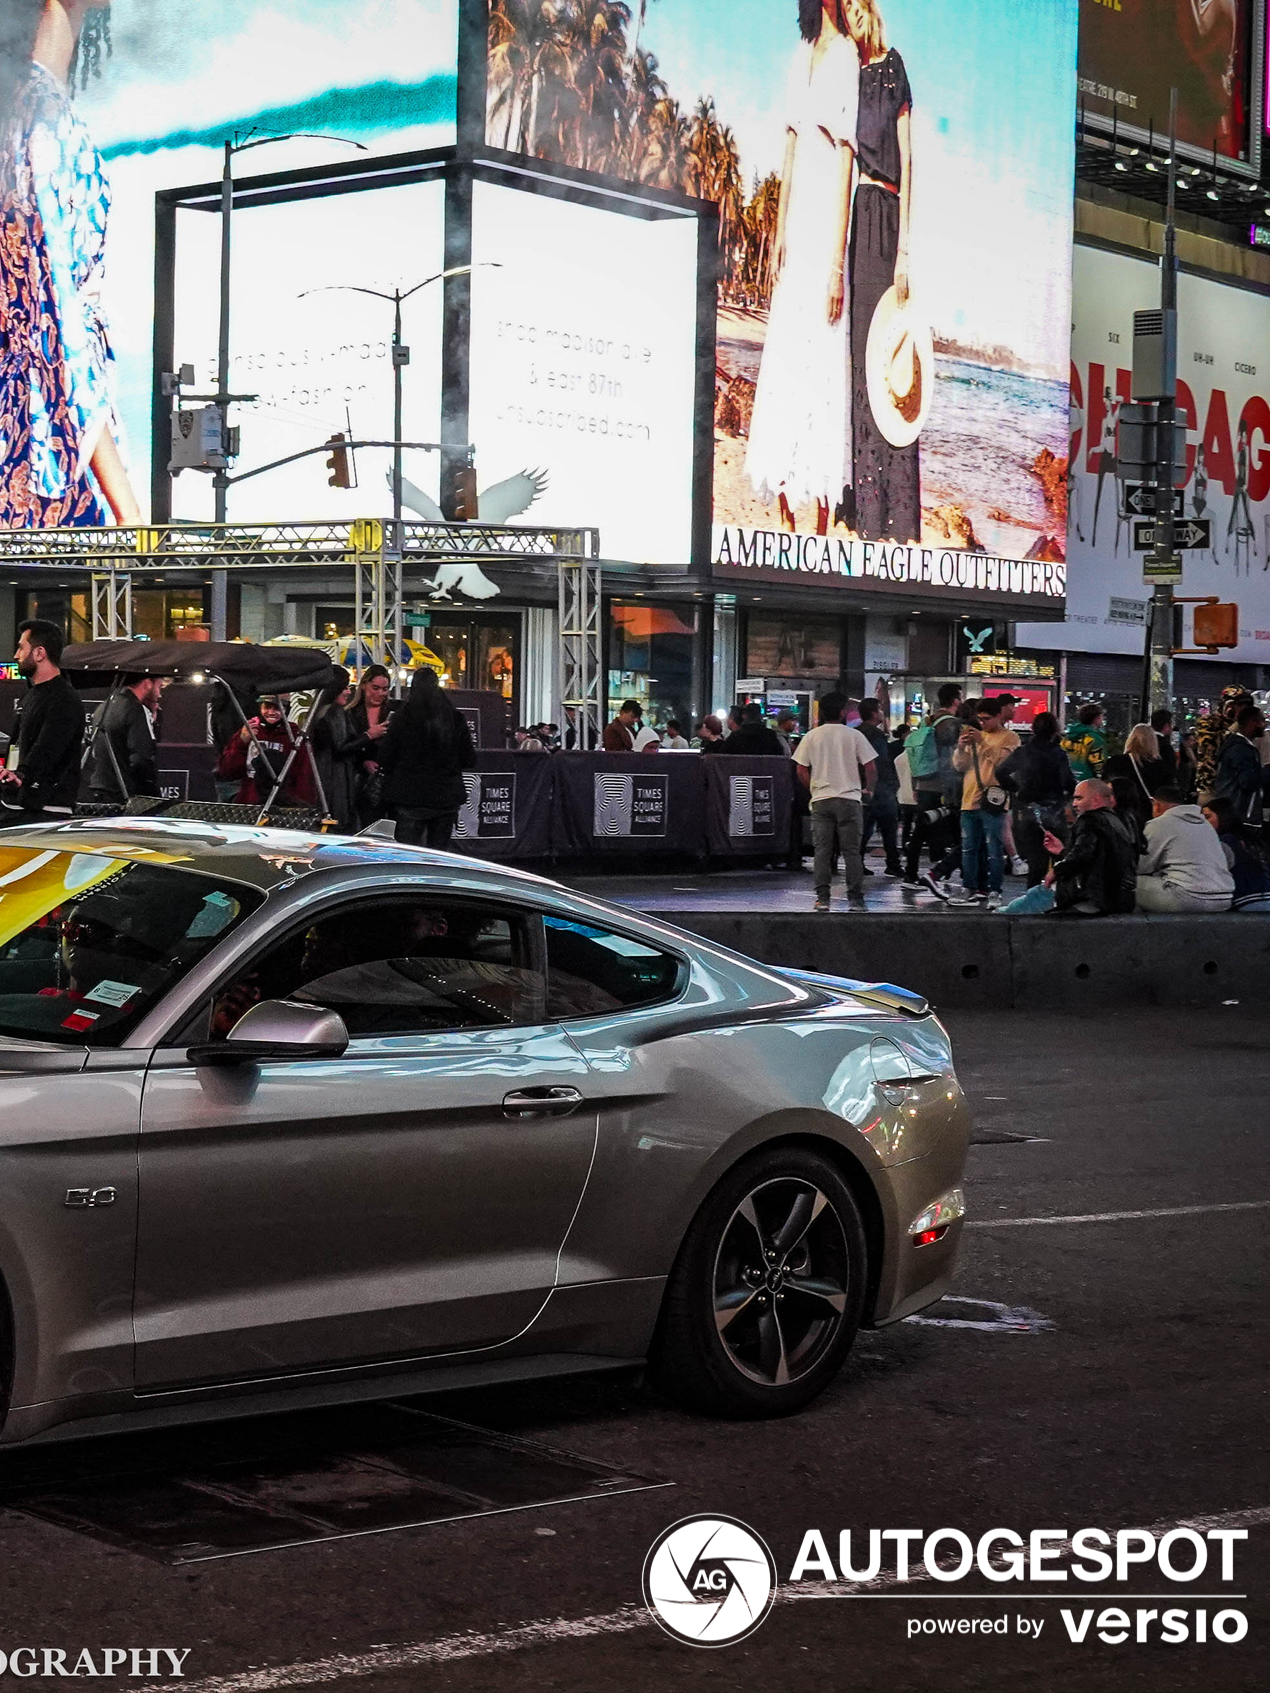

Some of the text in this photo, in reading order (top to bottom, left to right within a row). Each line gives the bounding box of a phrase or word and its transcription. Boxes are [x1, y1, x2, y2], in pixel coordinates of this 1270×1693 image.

[1234, 361, 1256, 376] CICERO
[718, 526, 1067, 596] AMERICAN EAGLE OUTFITTERS
[485, 788, 509, 799] TIMES
[636, 788, 662, 800] TIMES
[481, 801, 511, 813] SQUARE
[633, 801, 663, 813] SQUARE
[634, 814, 662, 824] ALLIANCE
[65, 1186, 117, 1207] 5.0
